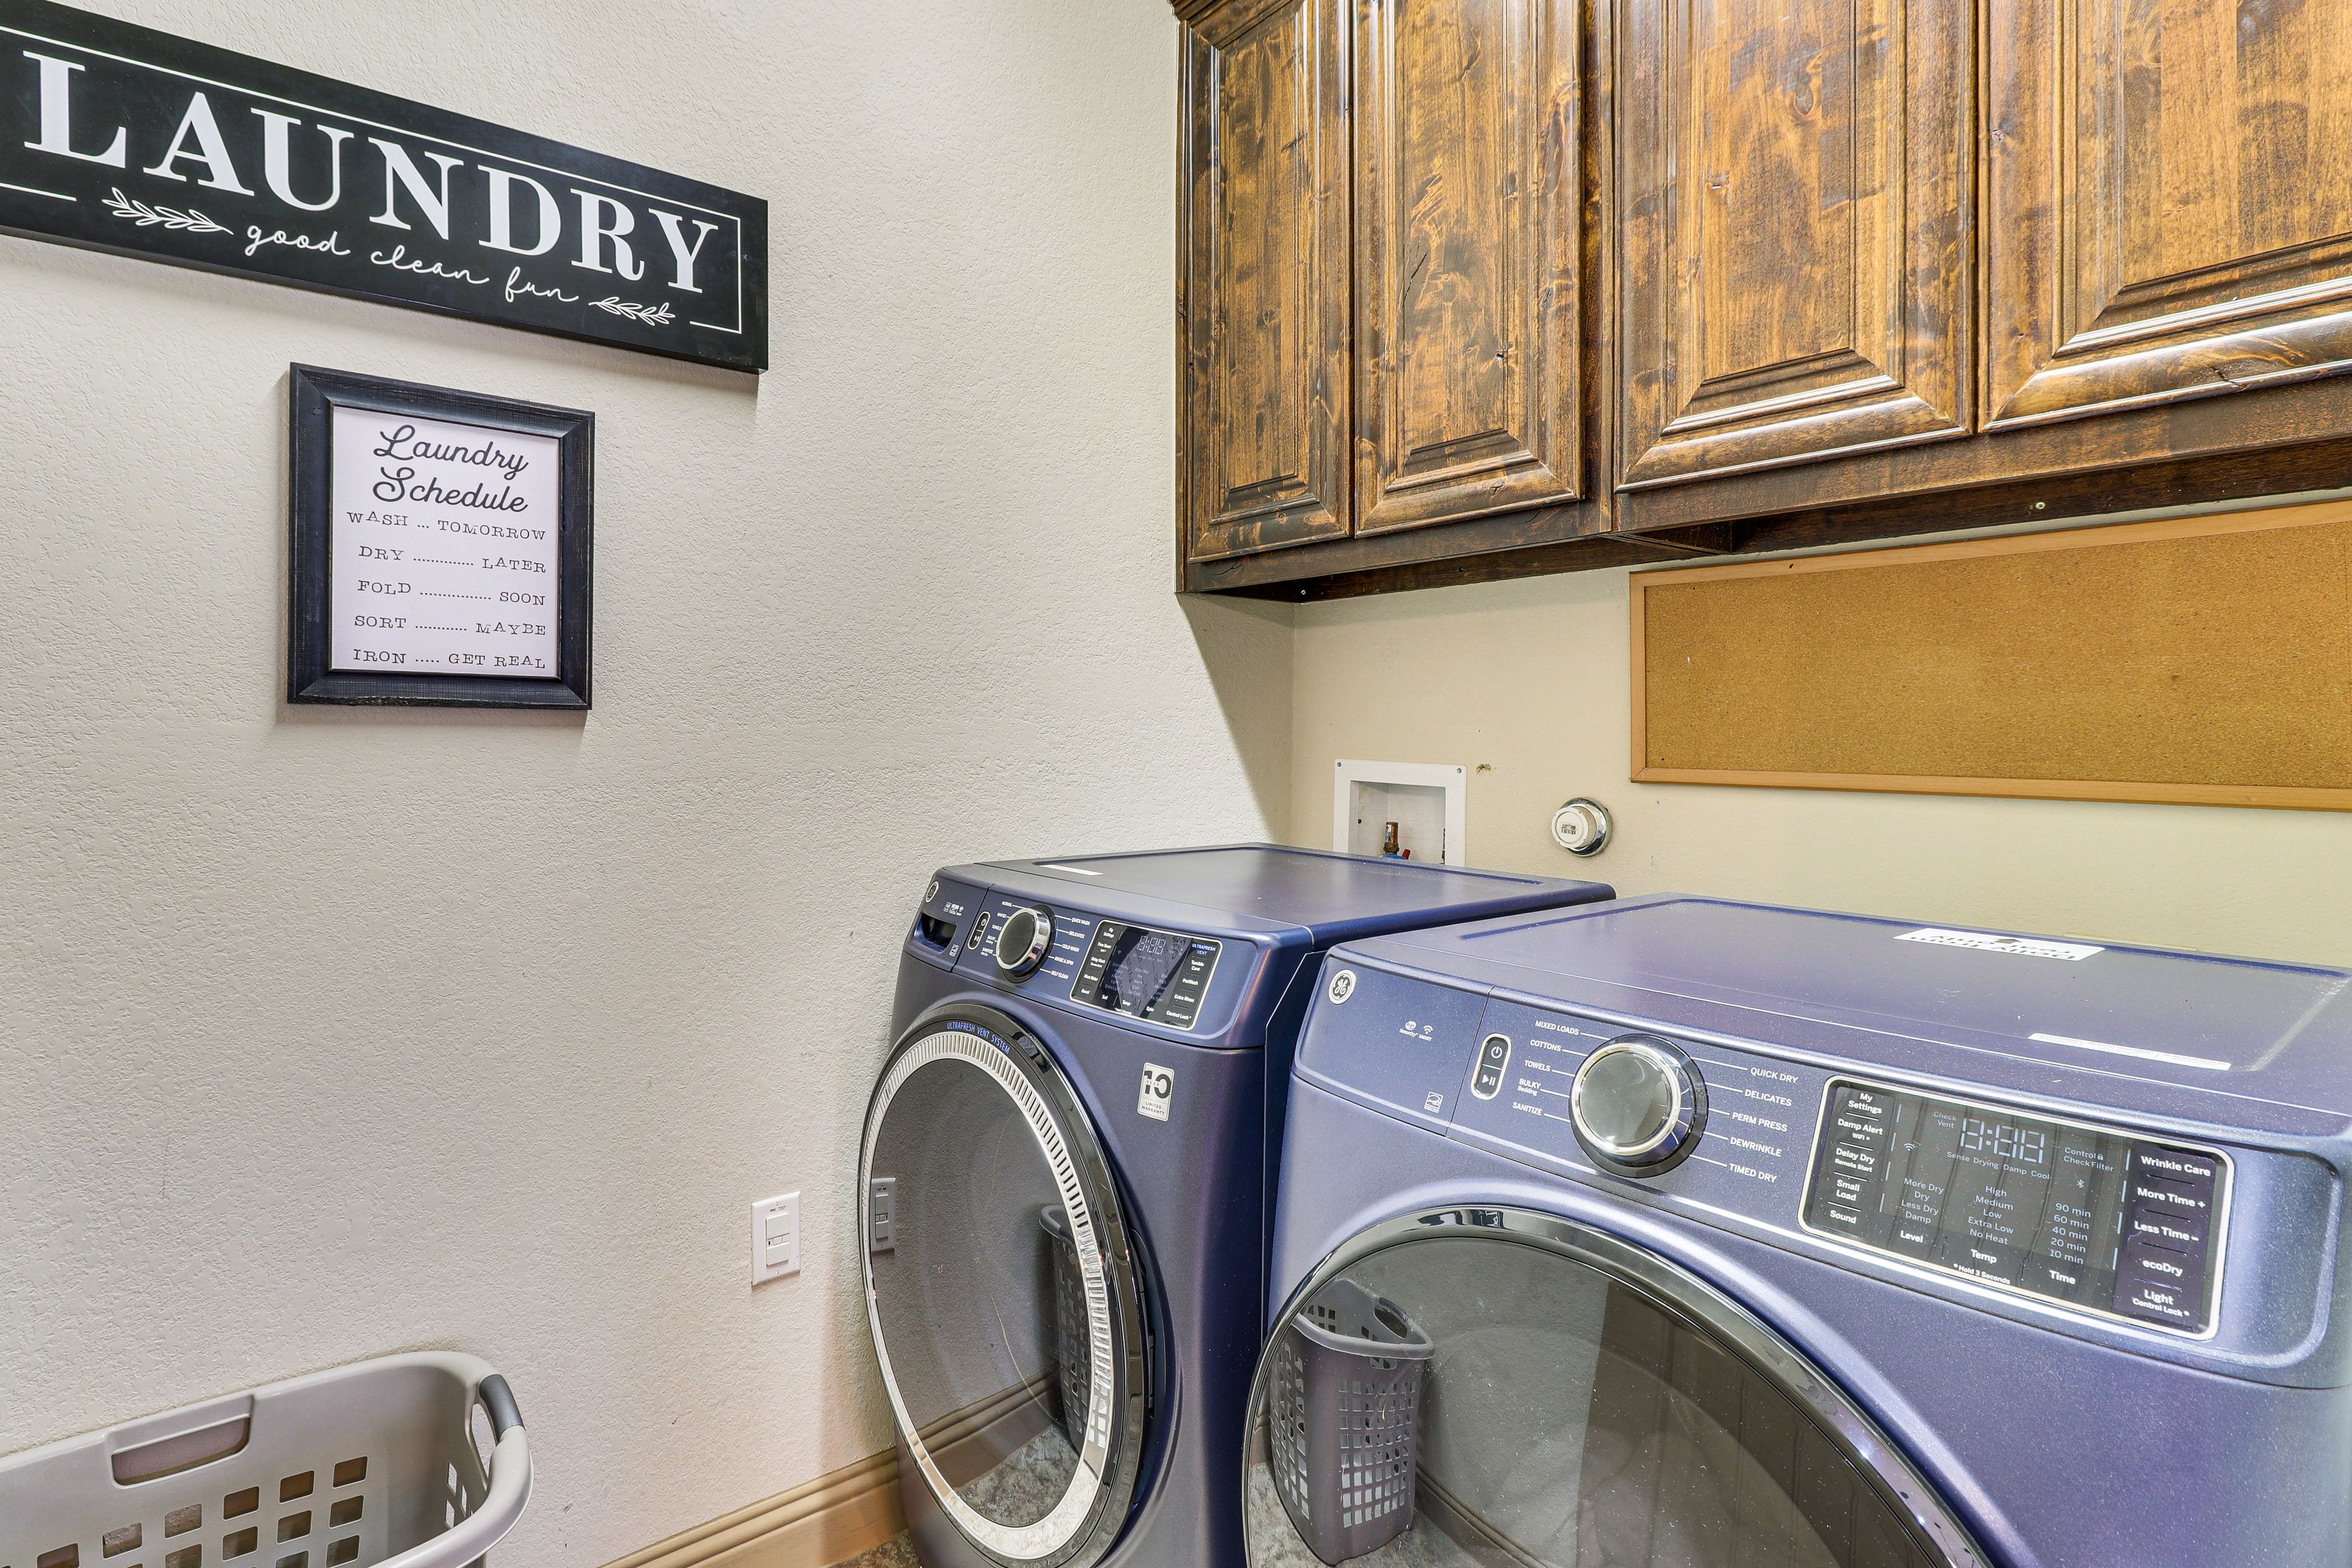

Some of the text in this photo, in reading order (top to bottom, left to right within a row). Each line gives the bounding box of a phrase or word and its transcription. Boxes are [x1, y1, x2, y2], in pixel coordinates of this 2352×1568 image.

[24, 49, 718, 293] LAUNDRY
[246, 222, 579, 304] good clean fun
[373, 424, 529, 480] Laundry
[372, 467, 528, 512] Schedule
[347, 511, 546, 540] WASH TOMORROW
[359, 546, 546, 573] DRY LATER
[357, 581, 545, 606] FOLD SOON
[355, 616, 546, 636] SORT MAYBE
[353, 649, 545, 668] IRON GET REAL
[1536, 1020, 1579, 1036] MIXED LOADS
[947, 1022, 1010, 1054] ULTRAFRESH VENT SYSTEM
[1530, 1039, 1562, 1052] COTTONS
[1525, 1060, 1551, 1072] TOWELS
[1519, 1078, 1541, 1089] BULKY
[1751, 1067, 1799, 1084] QUICK DRY
[1144, 1071, 1171, 1098] 10
[1518, 1085, 1537, 1096] Bedding
[1745, 1089, 1792, 1106] DELICATES
[1860, 1093, 1872, 1102] My
[1142, 1106, 1164, 1115] WARRANTY
[1512, 1102, 1542, 1115] SANITIZE
[1849, 1100, 1882, 1114] Settings
[1732, 1112, 1787, 1132] PERM PRESS
[1933, 1112, 1957, 1121] Check
[1937, 1120, 1954, 1129] Vent
[1838, 1118, 1883, 1135] Damp Alert
[1730, 1137, 1782, 1157] DEWRINKLE
[2065, 1147, 2096, 1159] Control
[1836, 1148, 1875, 1164] Delay Dry
[2064, 1156, 2114, 1172] Check Filter
[1730, 1163, 1777, 1183] TIMED DRY
[1835, 1158, 1873, 1173] Remote Start
[1947, 1152, 2050, 1180] Sense Drying Damp Cool
[2141, 1155, 2211, 1177] Wrinkle Care
[1837, 1180, 1860, 1192] Small
[1904, 1177, 1944, 1194] More Dry
[1986, 1185, 2007, 1197] High
[1836, 1189, 1856, 1202] Load
[1914, 1191, 1930, 1202] Dry
[1976, 1195, 2013, 1211] Medium
[2138, 1187, 2166, 1200] More
[2167, 1193, 2195, 1207] Time
[1901, 1199, 1939, 1215] Less Dry
[1983, 1208, 2002, 1219] Low
[2056, 1203, 2091, 1218] 90 min
[1830, 1210, 1856, 1224] Sound
[1905, 1211, 1931, 1224] Damp
[1968, 1216, 2014, 1234] Extra Low
[2054, 1215, 2089, 1229] 60 min
[1900, 1230, 1923, 1243] Level
[1970, 1229, 2009, 1245] No Heat
[2052, 1226, 2087, 1242] 40 min
[2134, 1221, 2160, 1234] Less
[2160, 1226, 2190, 1241] Time
[2051, 1238, 2086, 1253] 20 min
[1970, 1248, 1997, 1264] Temp
[2049, 1249, 2083, 1265] 10 min
[2143, 1259, 2183, 1277] ecoDry
[1981, 1272, 2010, 1285] Seconds
[2049, 1270, 2076, 1285] Time
[2144, 1289, 2174, 1306] Light
[2132, 1297, 2182, 1317] Control Lock
